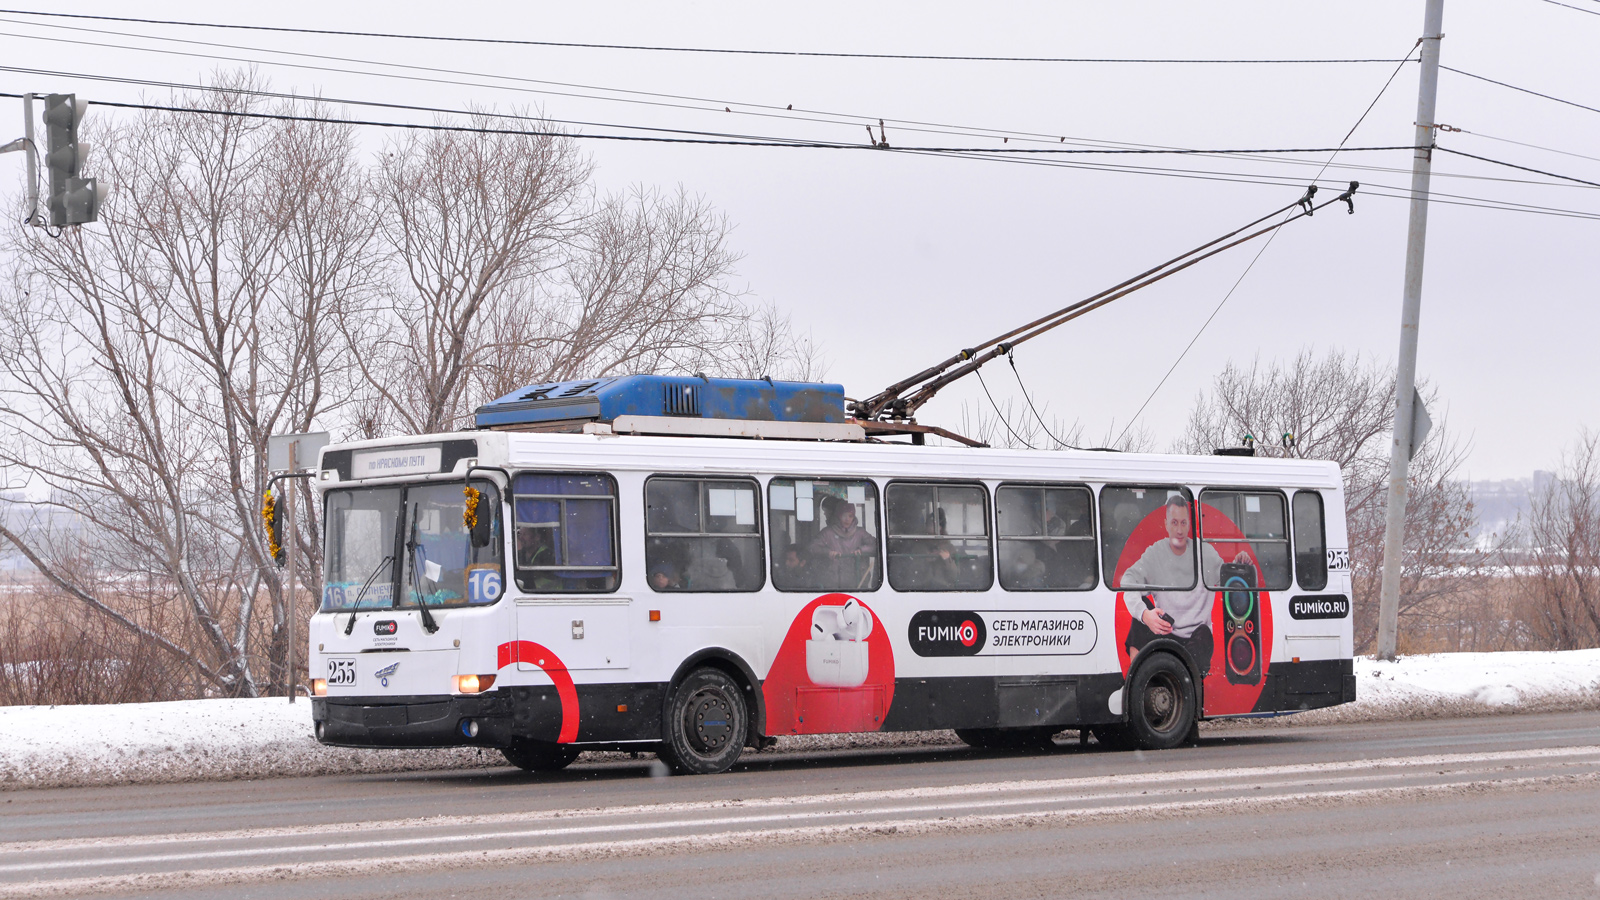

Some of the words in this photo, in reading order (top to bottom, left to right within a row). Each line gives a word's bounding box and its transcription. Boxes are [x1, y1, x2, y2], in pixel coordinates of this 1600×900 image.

[368, 461, 377, 470] по
[377, 456, 408, 470] КРАСНОМУ
[409, 455, 426, 467] ПУТИ
[1328, 550, 1350, 570] 255
[356, 585, 393, 596] СЛНЕЧ
[468, 572, 501, 600] 16
[327, 587, 343, 607] 16
[1294, 601, 1346, 614] FUMIKO.RU
[992, 620, 1019, 631] СЕТЬ
[1021, 620, 1084, 631] МАГАЗИНОВ
[918, 626, 974, 641] FUMIKO
[992, 635, 1071, 647] ЭЛЕКТРОНИКИ
[328, 660, 356, 684] 255
